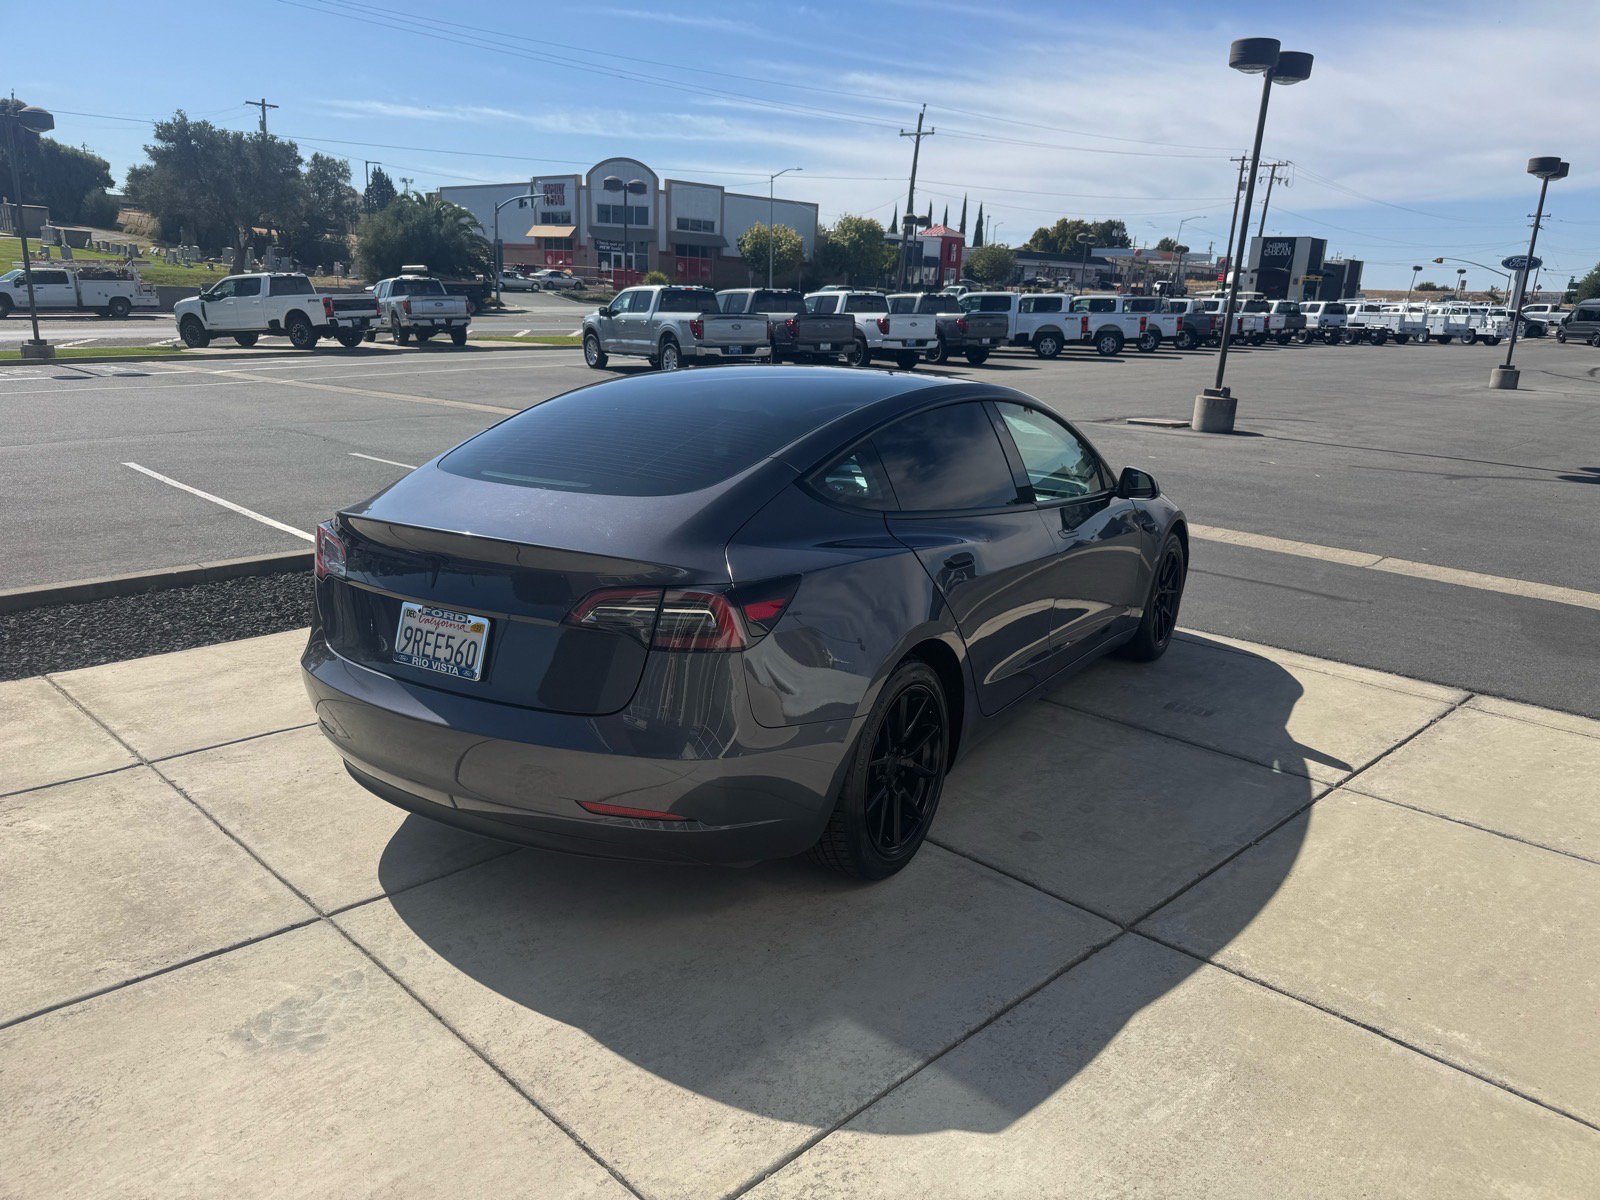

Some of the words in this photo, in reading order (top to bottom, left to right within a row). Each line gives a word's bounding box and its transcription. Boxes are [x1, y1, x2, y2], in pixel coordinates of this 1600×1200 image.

[1271, 247, 1291, 256] BEAN
[406, 609, 416, 618] DEC
[422, 608, 467, 623] FORD
[418, 614, 470, 633] California
[400, 626, 478, 669] 9REE560
[412, 657, 429, 667] RIO
[432, 663, 459, 676] VISTA
